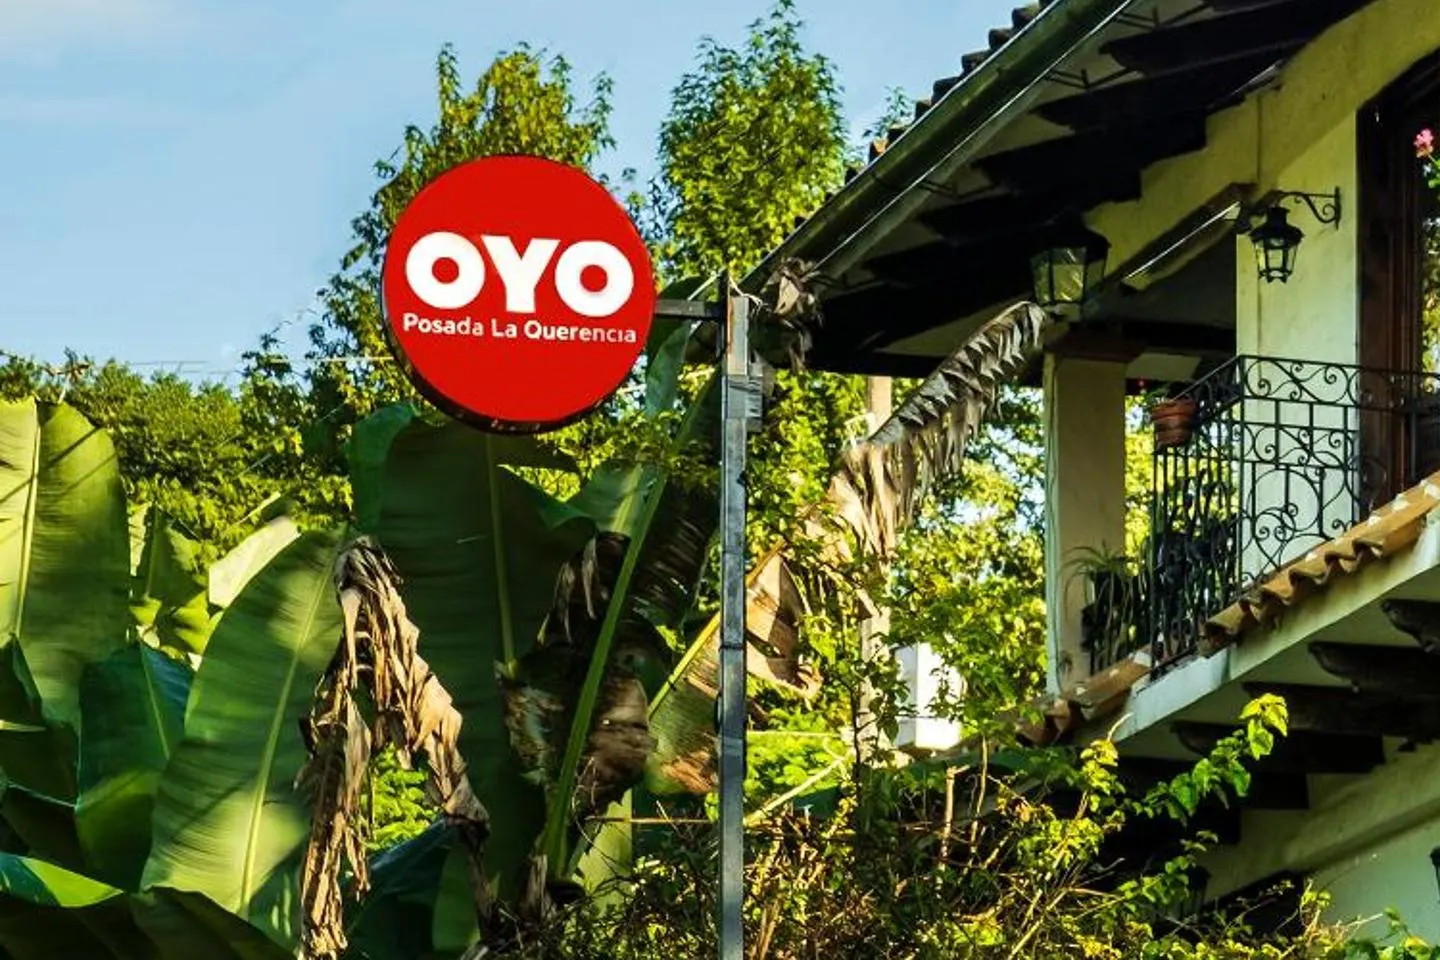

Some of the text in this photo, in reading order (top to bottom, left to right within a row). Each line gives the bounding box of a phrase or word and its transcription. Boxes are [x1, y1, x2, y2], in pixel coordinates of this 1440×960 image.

[405, 231, 634, 317] OYO
[403, 312, 637, 343] Posada La Querencia
